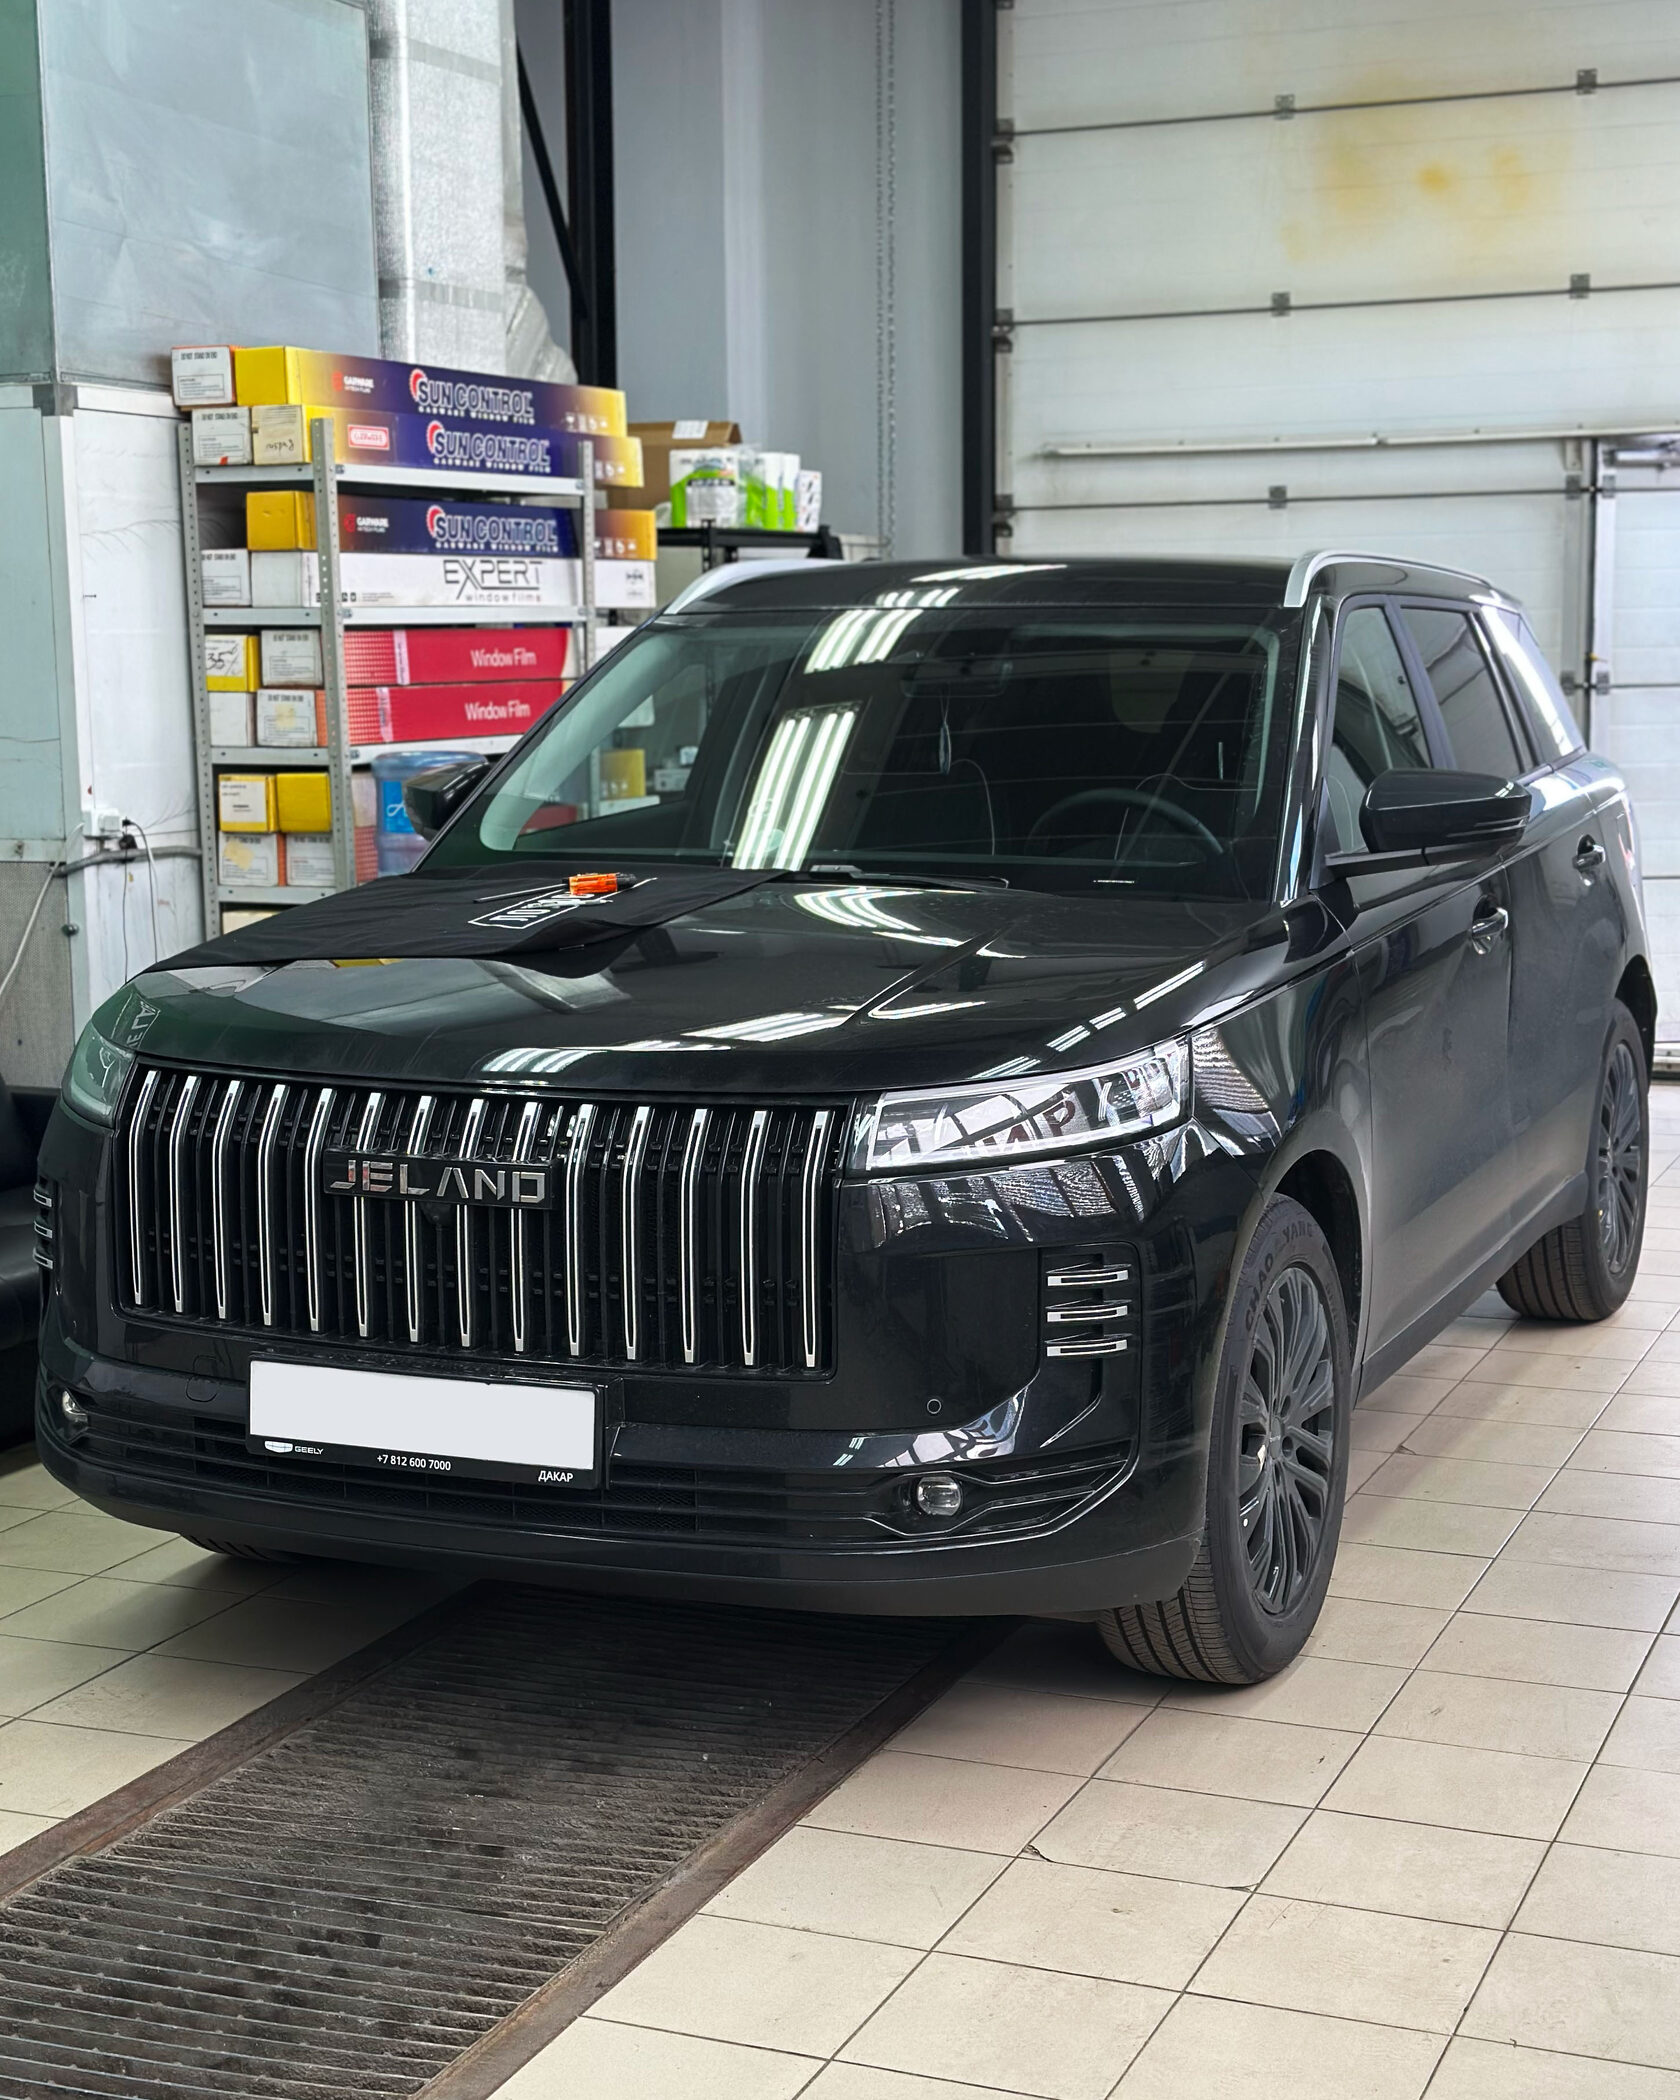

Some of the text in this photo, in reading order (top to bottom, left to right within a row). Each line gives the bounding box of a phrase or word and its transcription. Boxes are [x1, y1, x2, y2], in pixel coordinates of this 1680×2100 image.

[418, 378, 535, 418] SUN CONTROL
[434, 428, 551, 466] SUN CONTROL
[435, 513, 558, 546] SUN CONTROL
[443, 559, 543, 600] EXPERT
[470, 647, 537, 668] Window Film
[465, 699, 531, 720] Window Film
[330, 1159, 546, 1203] JELAND
[294, 1445, 324, 1455] GEELY
[376, 1454, 451, 1471] +7 812 600 7000
[538, 1470, 574, 1483] ДАКАР
